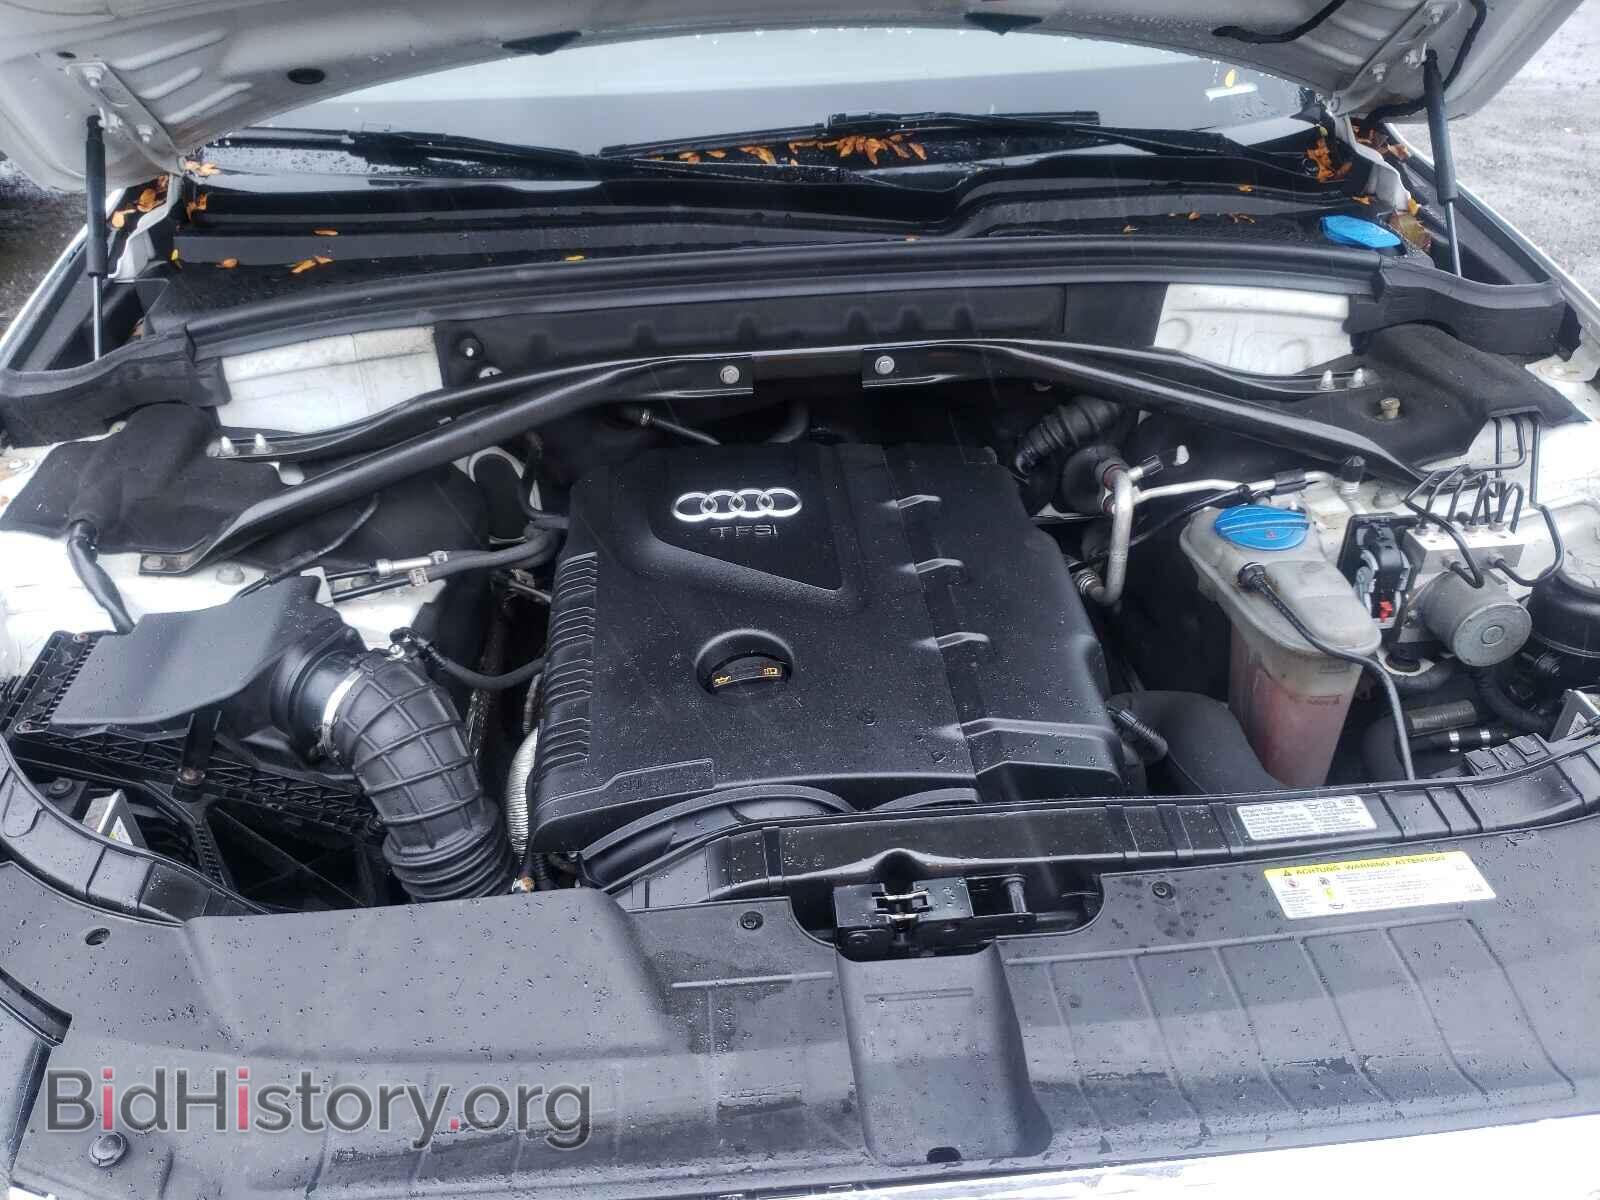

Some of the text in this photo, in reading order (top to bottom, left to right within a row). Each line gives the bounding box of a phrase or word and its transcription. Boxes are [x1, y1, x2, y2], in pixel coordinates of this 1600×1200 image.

[710, 524, 778, 538] TFSI
[1296, 855, 1446, 876] ACHTUNG WARNING ATTENTION
